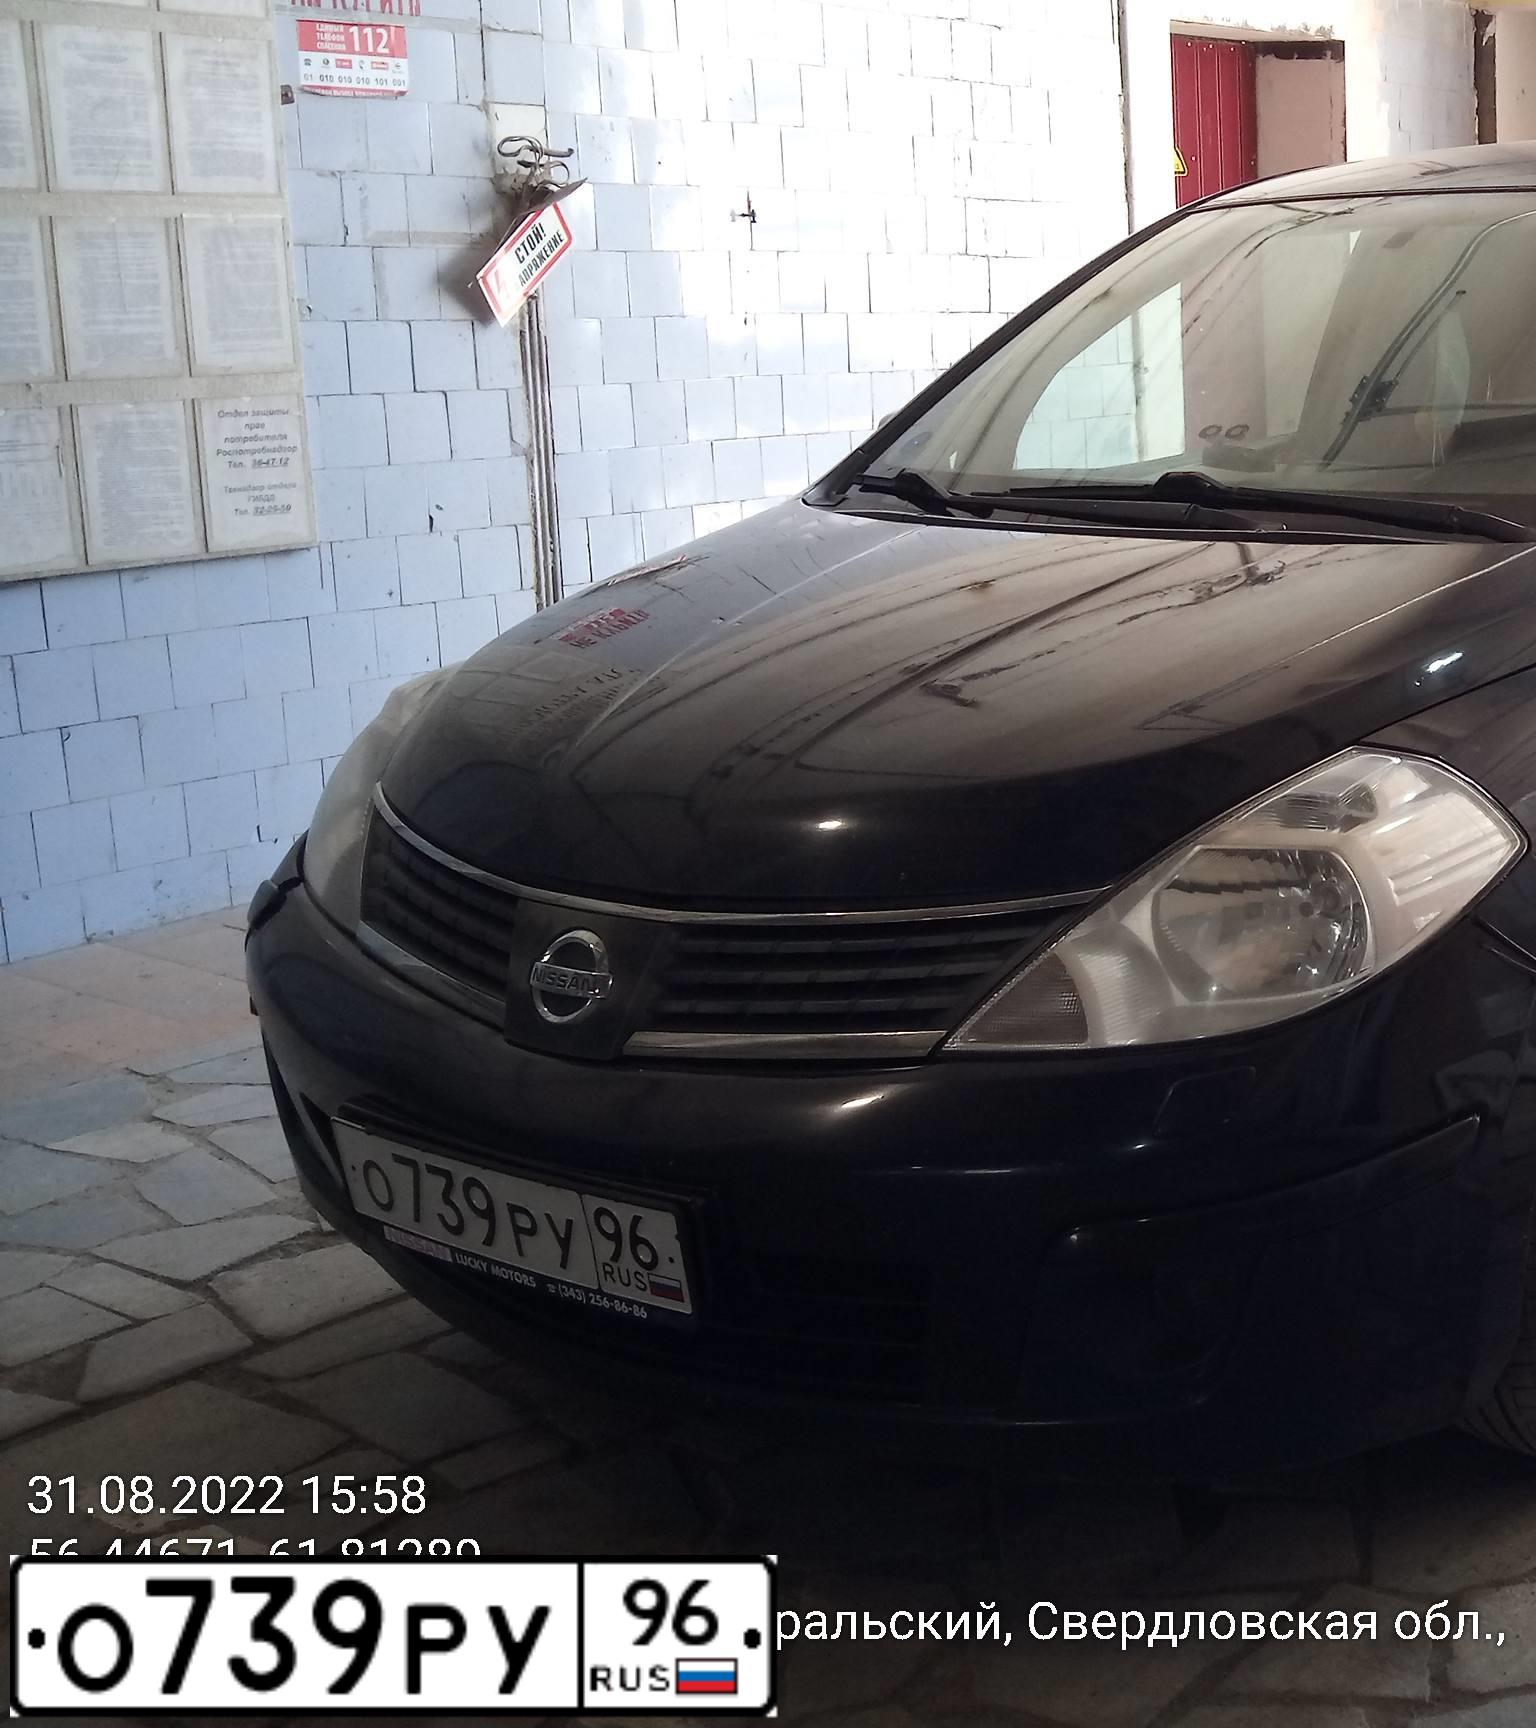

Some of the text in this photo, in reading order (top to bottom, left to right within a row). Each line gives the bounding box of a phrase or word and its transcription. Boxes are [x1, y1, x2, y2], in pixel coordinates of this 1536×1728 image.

[349, 26, 390, 54] 112
[319, 74, 334, 83] 010
[338, 75, 352, 84] 010
[356, 76, 370, 85] 010
[374, 77, 388, 86] 101
[514, 221, 547, 264] СТОЙ!
[518, 230, 565, 287] АПРЯЖЕНИЕ
[217, 409, 290, 418] Отдел защиты
[244, 422, 265, 431] прав
[216, 445, 298, 456] Роспотребнадзор
[224, 434, 288, 444] потребителя
[531, 965, 594, 994] NISSAN
[362, 1153, 659, 1270] О739РУ 96
[455, 1252, 488, 1273] LUCKY
[491, 1263, 537, 1288] MOTORS
[559, 1284, 586, 1304] (343)
[588, 1293, 648, 1319] 256-86-86
[602, 1262, 648, 1292] RUS
